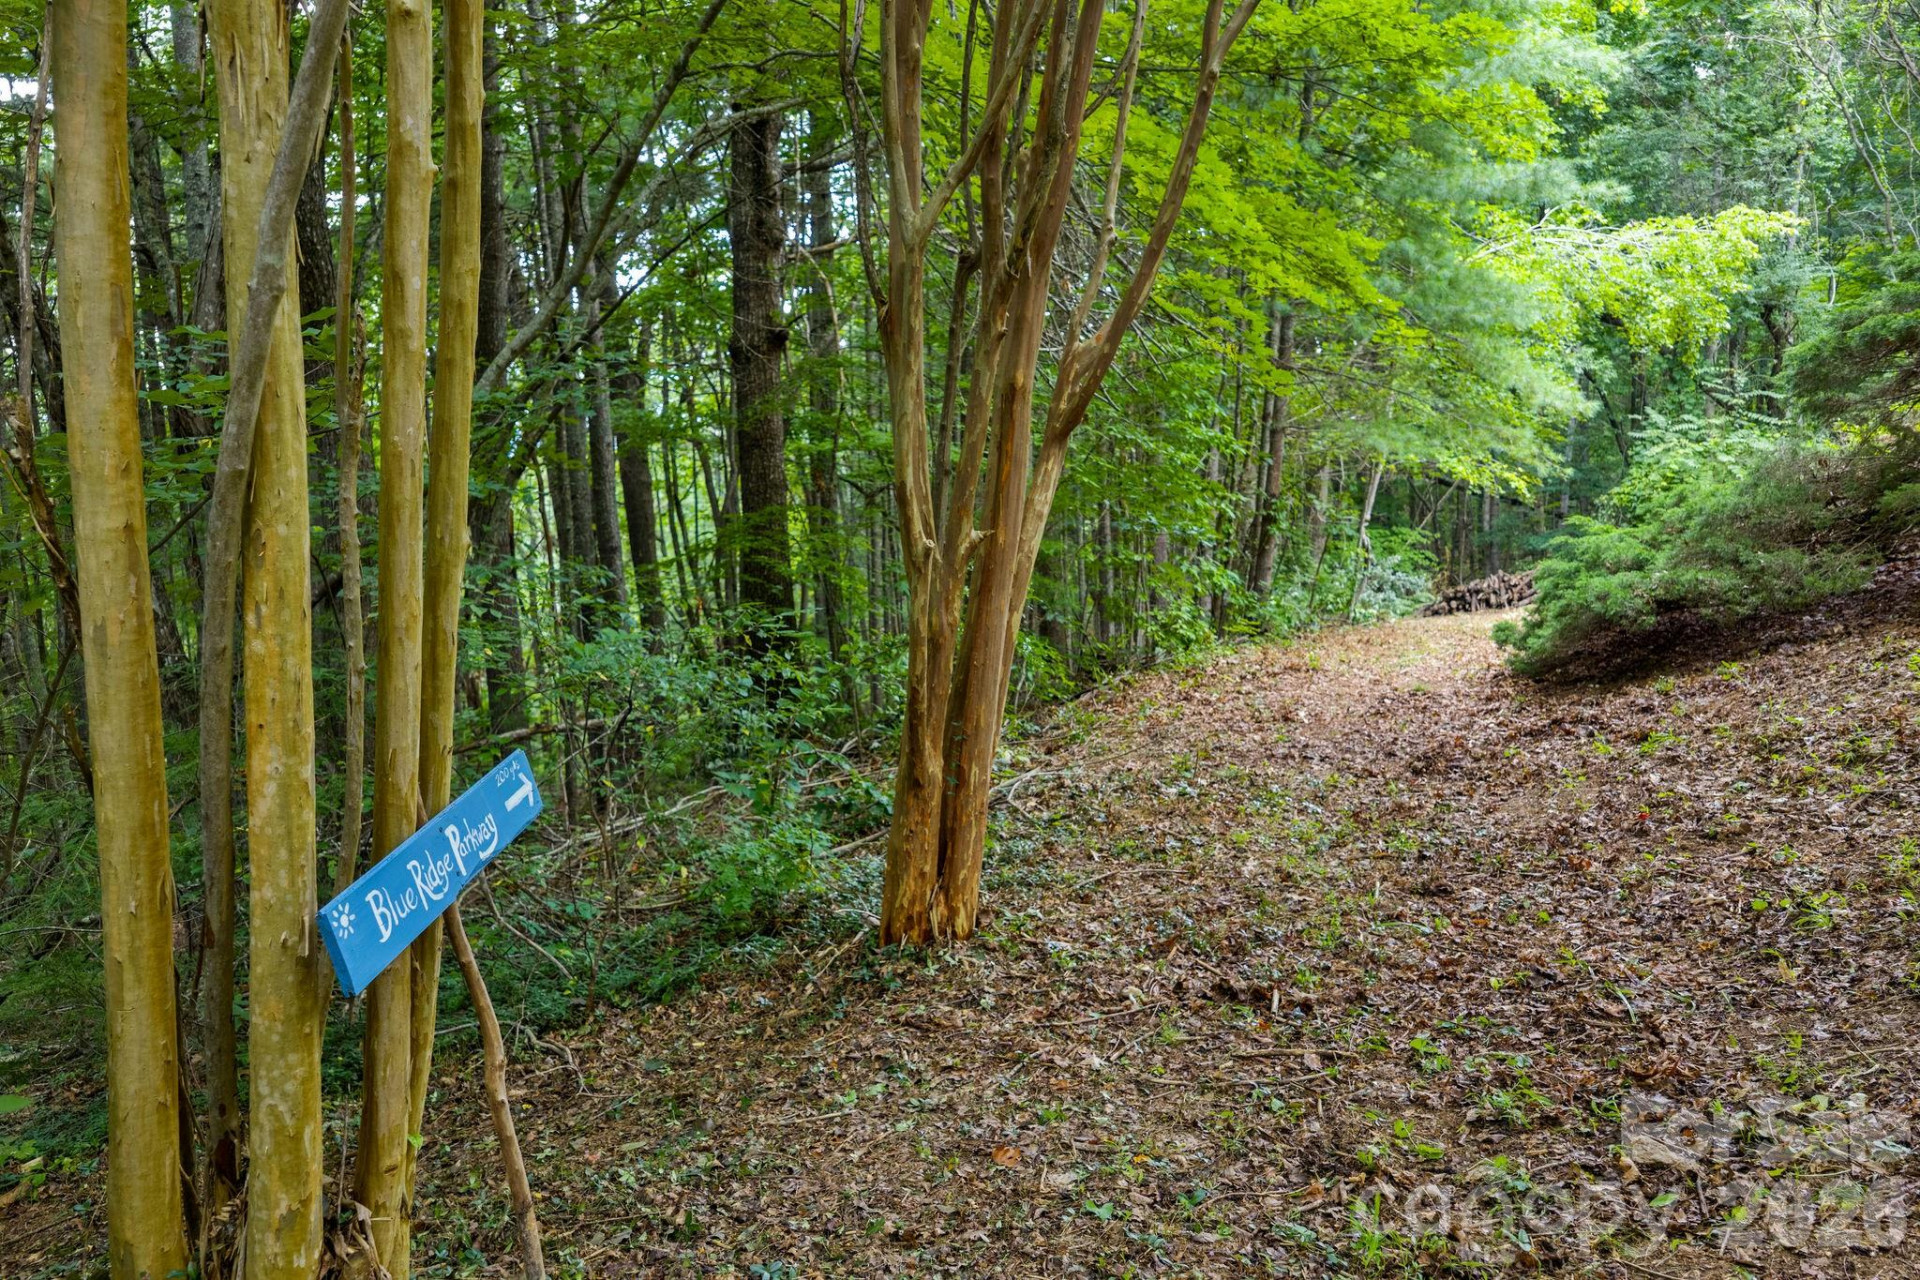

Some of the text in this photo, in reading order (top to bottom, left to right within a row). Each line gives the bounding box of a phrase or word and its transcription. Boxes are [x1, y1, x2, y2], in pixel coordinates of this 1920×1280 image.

[495, 767, 510, 787] 200
[365, 812, 499, 943] Blue Ridge Parkway
